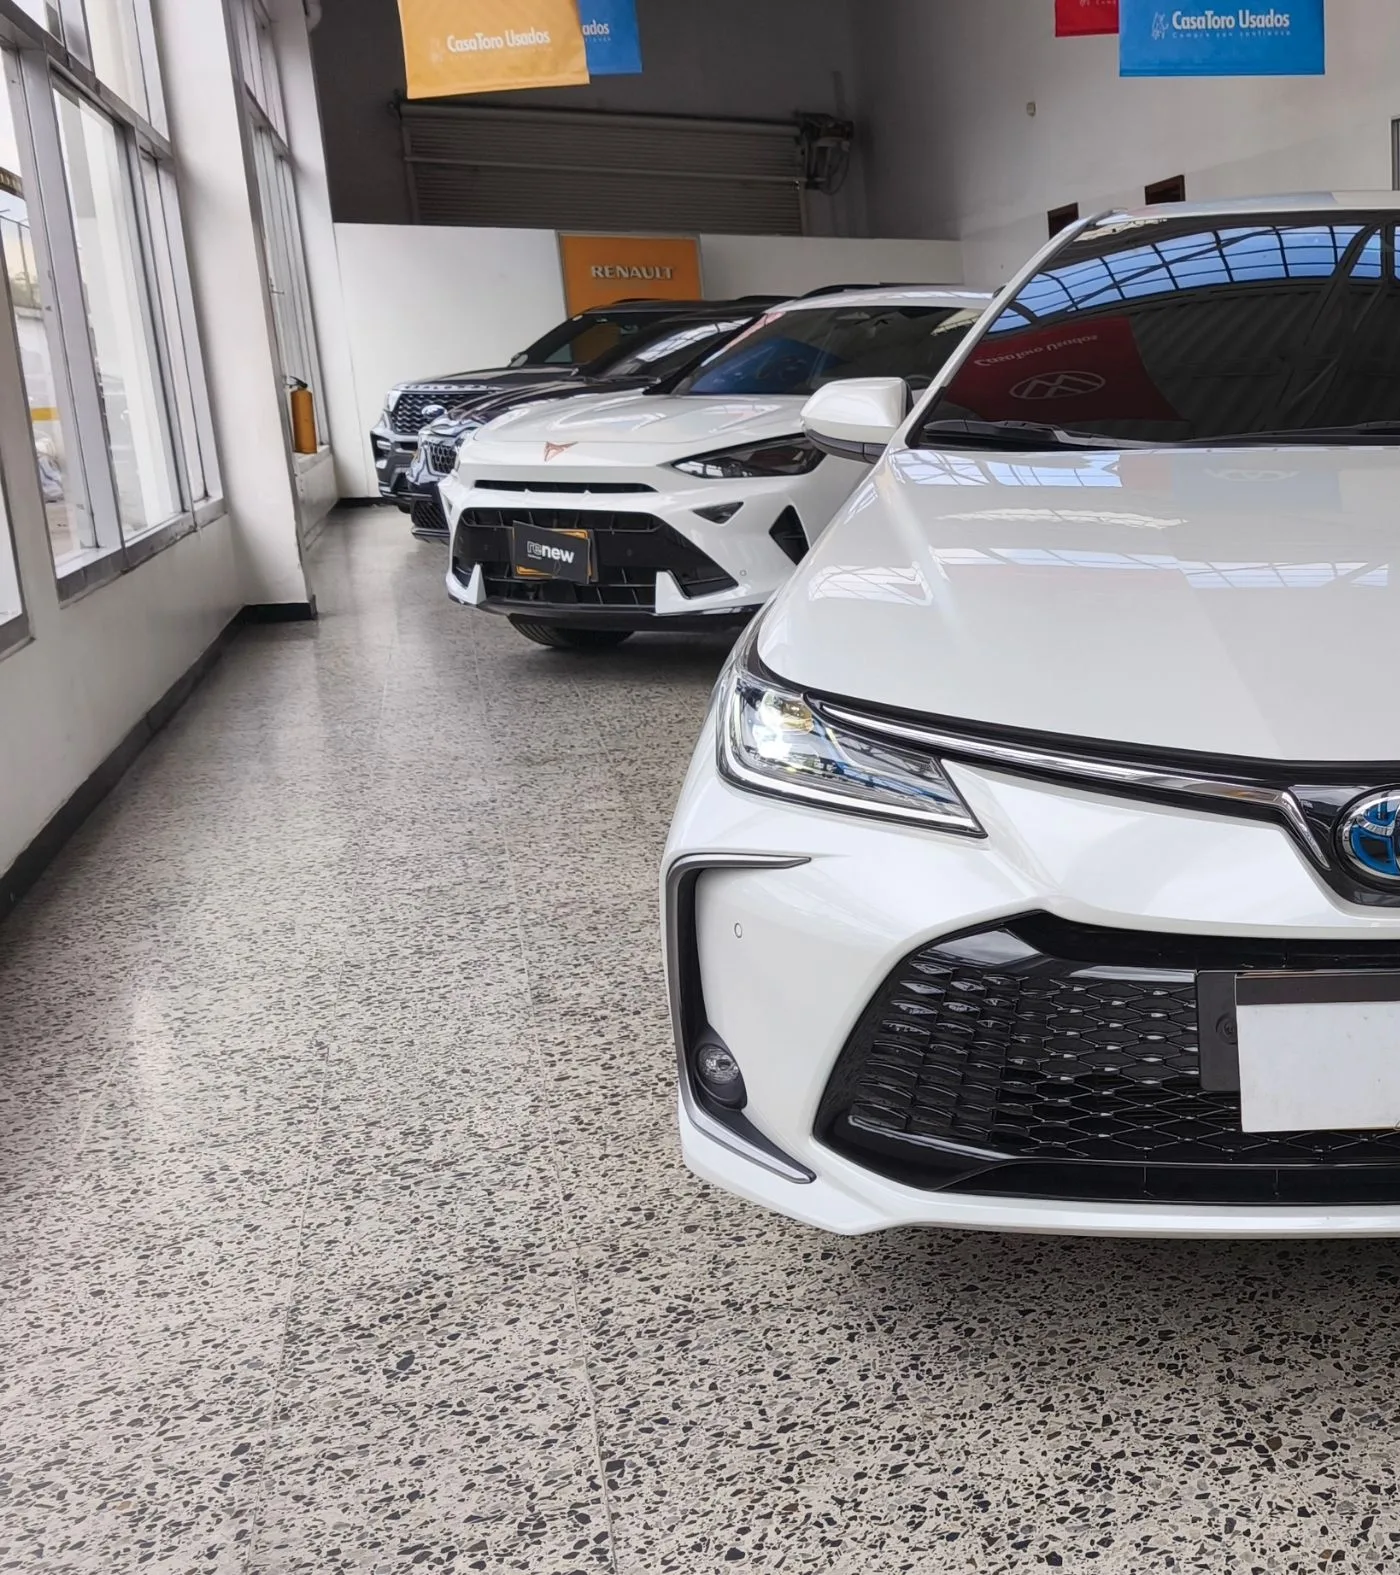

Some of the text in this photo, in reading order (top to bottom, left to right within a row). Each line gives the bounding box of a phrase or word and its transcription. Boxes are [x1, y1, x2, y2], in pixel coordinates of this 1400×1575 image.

[582, 19, 610, 35] ados
[1172, 8, 1290, 30] CasaToro Usados
[446, 26, 551, 53] CasaToro Usados
[591, 265, 674, 281] RENAULT
[527, 540, 575, 564] renew
